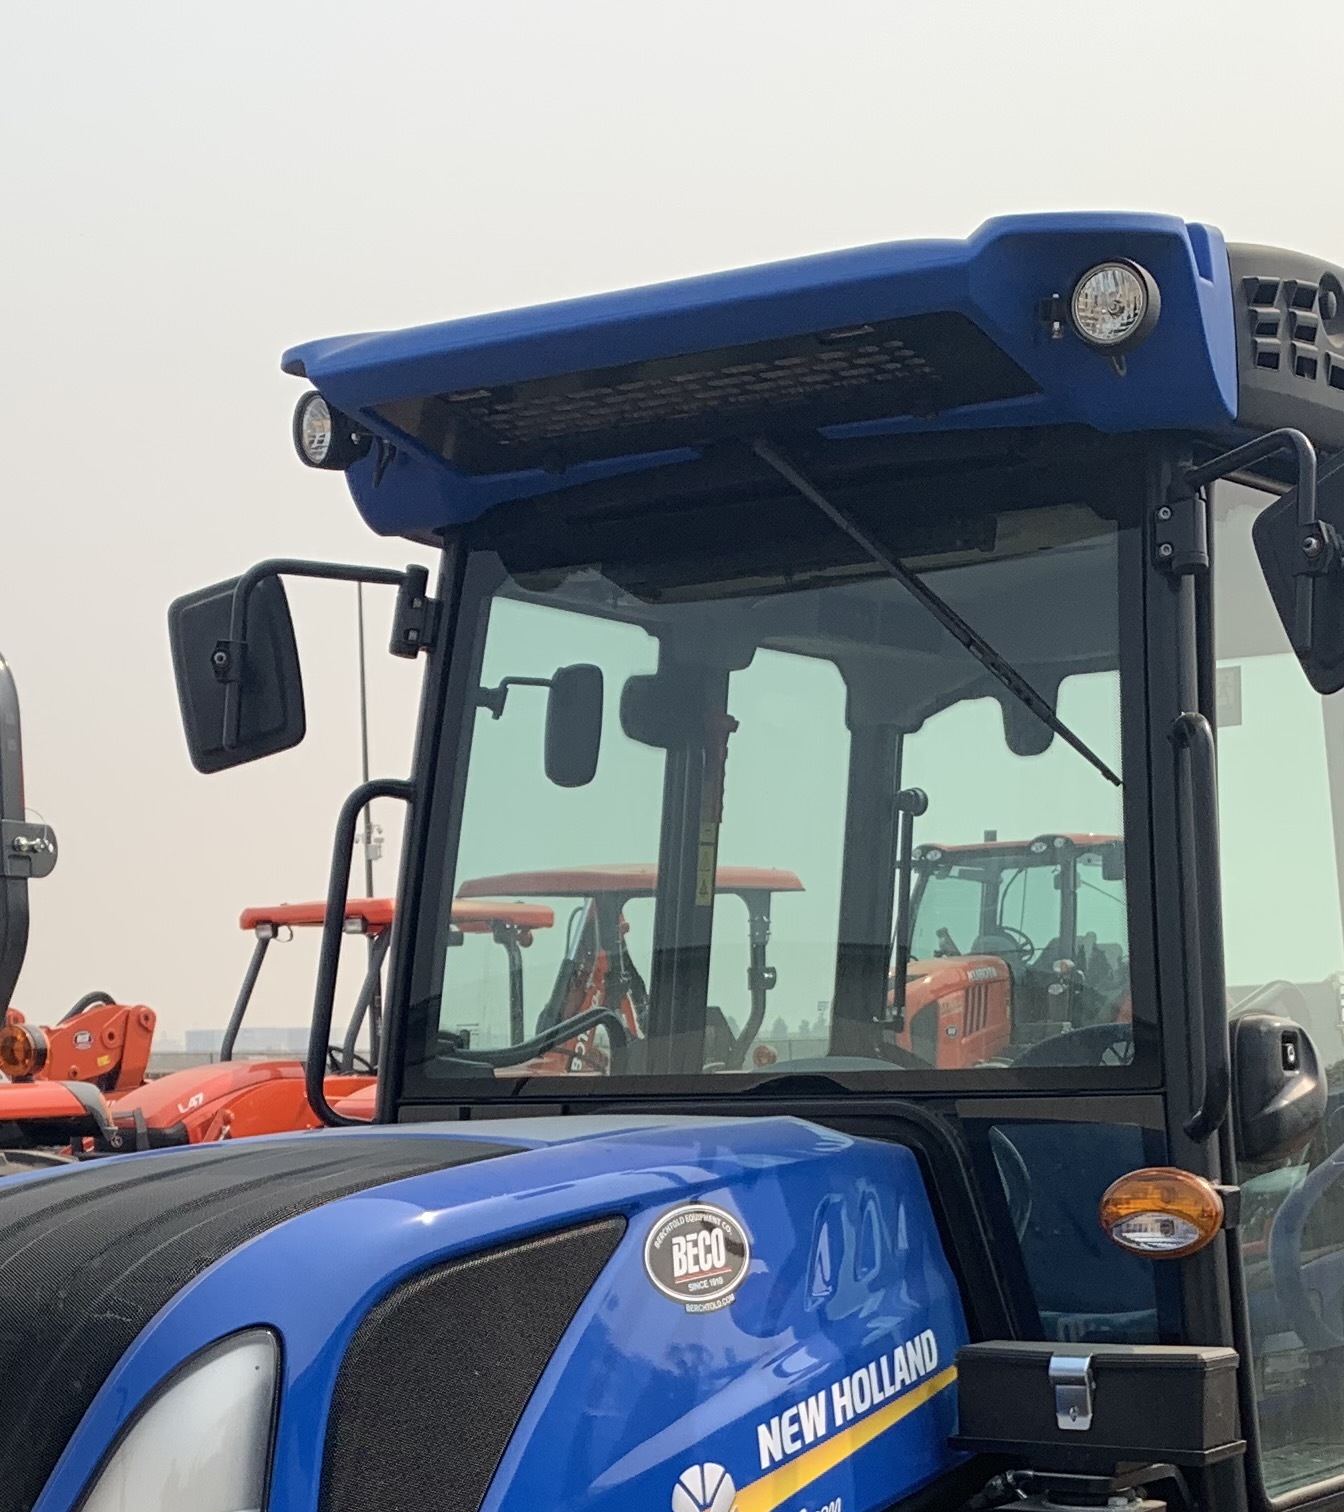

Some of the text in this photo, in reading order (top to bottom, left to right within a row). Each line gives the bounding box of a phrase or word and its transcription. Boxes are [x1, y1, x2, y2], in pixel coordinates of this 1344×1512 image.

[654, 1216, 685, 1249] BERCHTOLD
[685, 1212, 721, 1226] EQUIPMENT
[672, 1227, 726, 1278] BECO
[685, 1293, 735, 1313] BERCHTOLD.COM
[688, 1280, 709, 1292] SINCE
[757, 1328, 939, 1470] NEW HOLLAND
